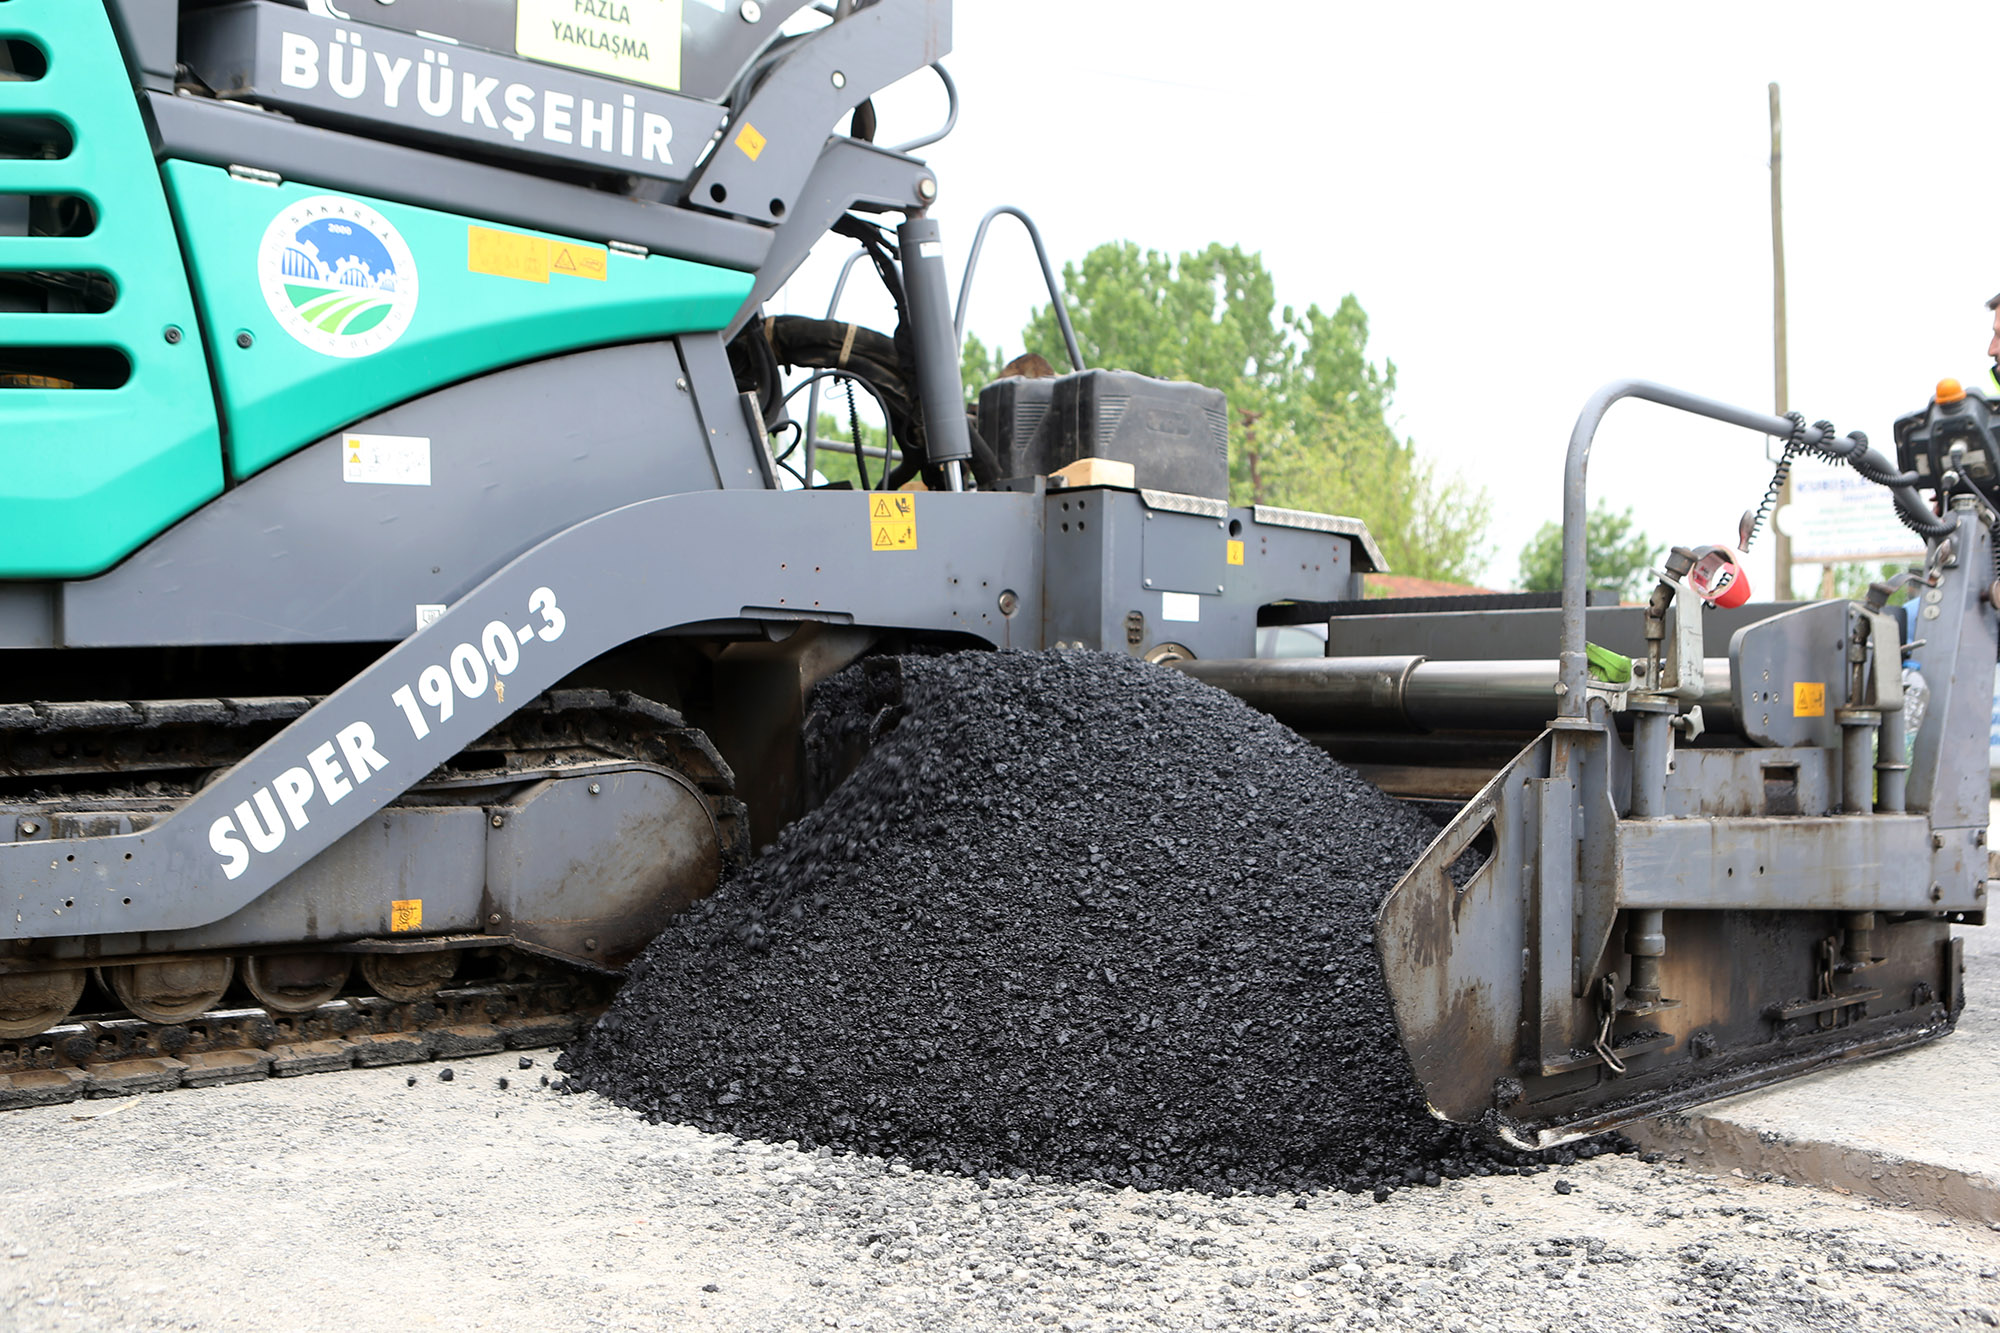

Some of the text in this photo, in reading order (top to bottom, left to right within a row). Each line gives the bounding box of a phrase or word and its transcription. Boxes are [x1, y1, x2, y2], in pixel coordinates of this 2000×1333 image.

[552, 20, 649, 60] YAKLAŞMA
[575, 0, 630, 24] FAZLA
[280, 28, 674, 165] BÜYÜKŞEHİR
[208, 586, 566, 880] SUPER 1900-3
